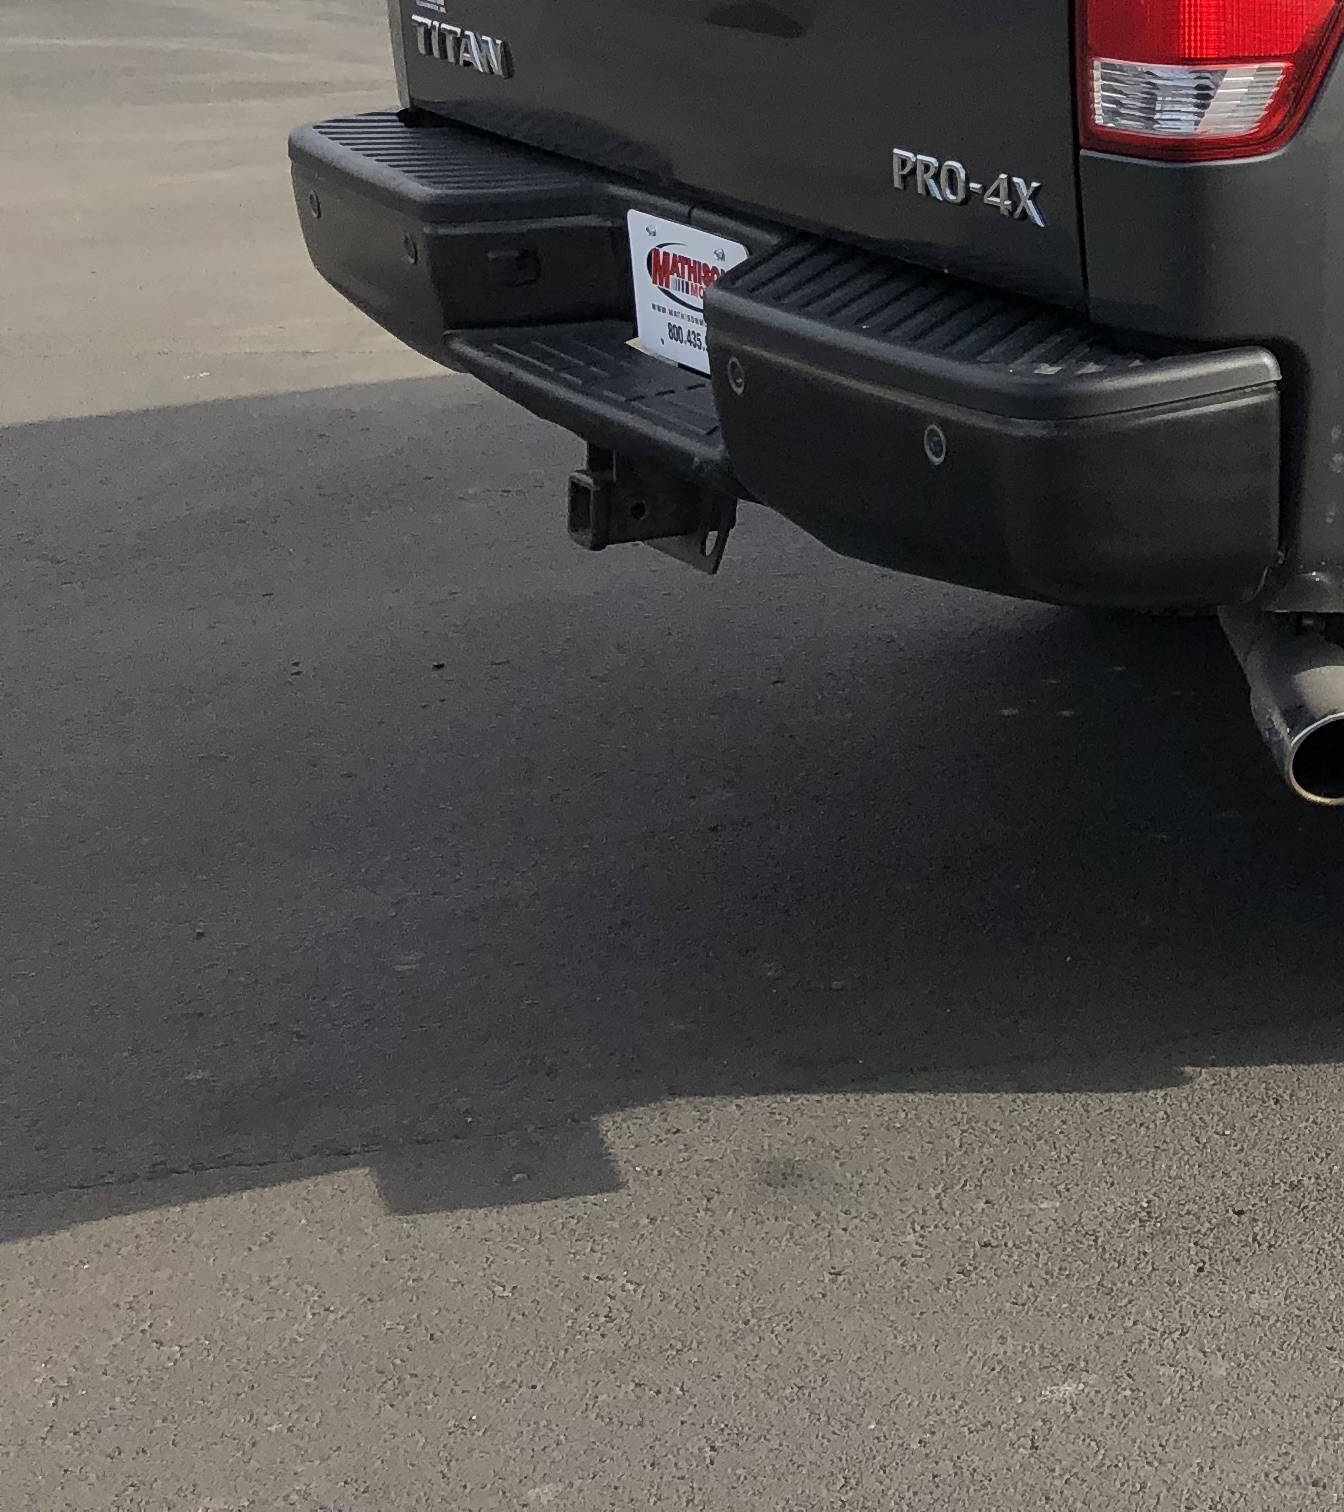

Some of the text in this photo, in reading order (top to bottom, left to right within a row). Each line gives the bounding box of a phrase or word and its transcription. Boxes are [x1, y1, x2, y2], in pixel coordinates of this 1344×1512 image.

[411, 15, 504, 78] TITAN
[891, 147, 1046, 228] PRO-4X
[667, 322, 709, 352] 800.435.
